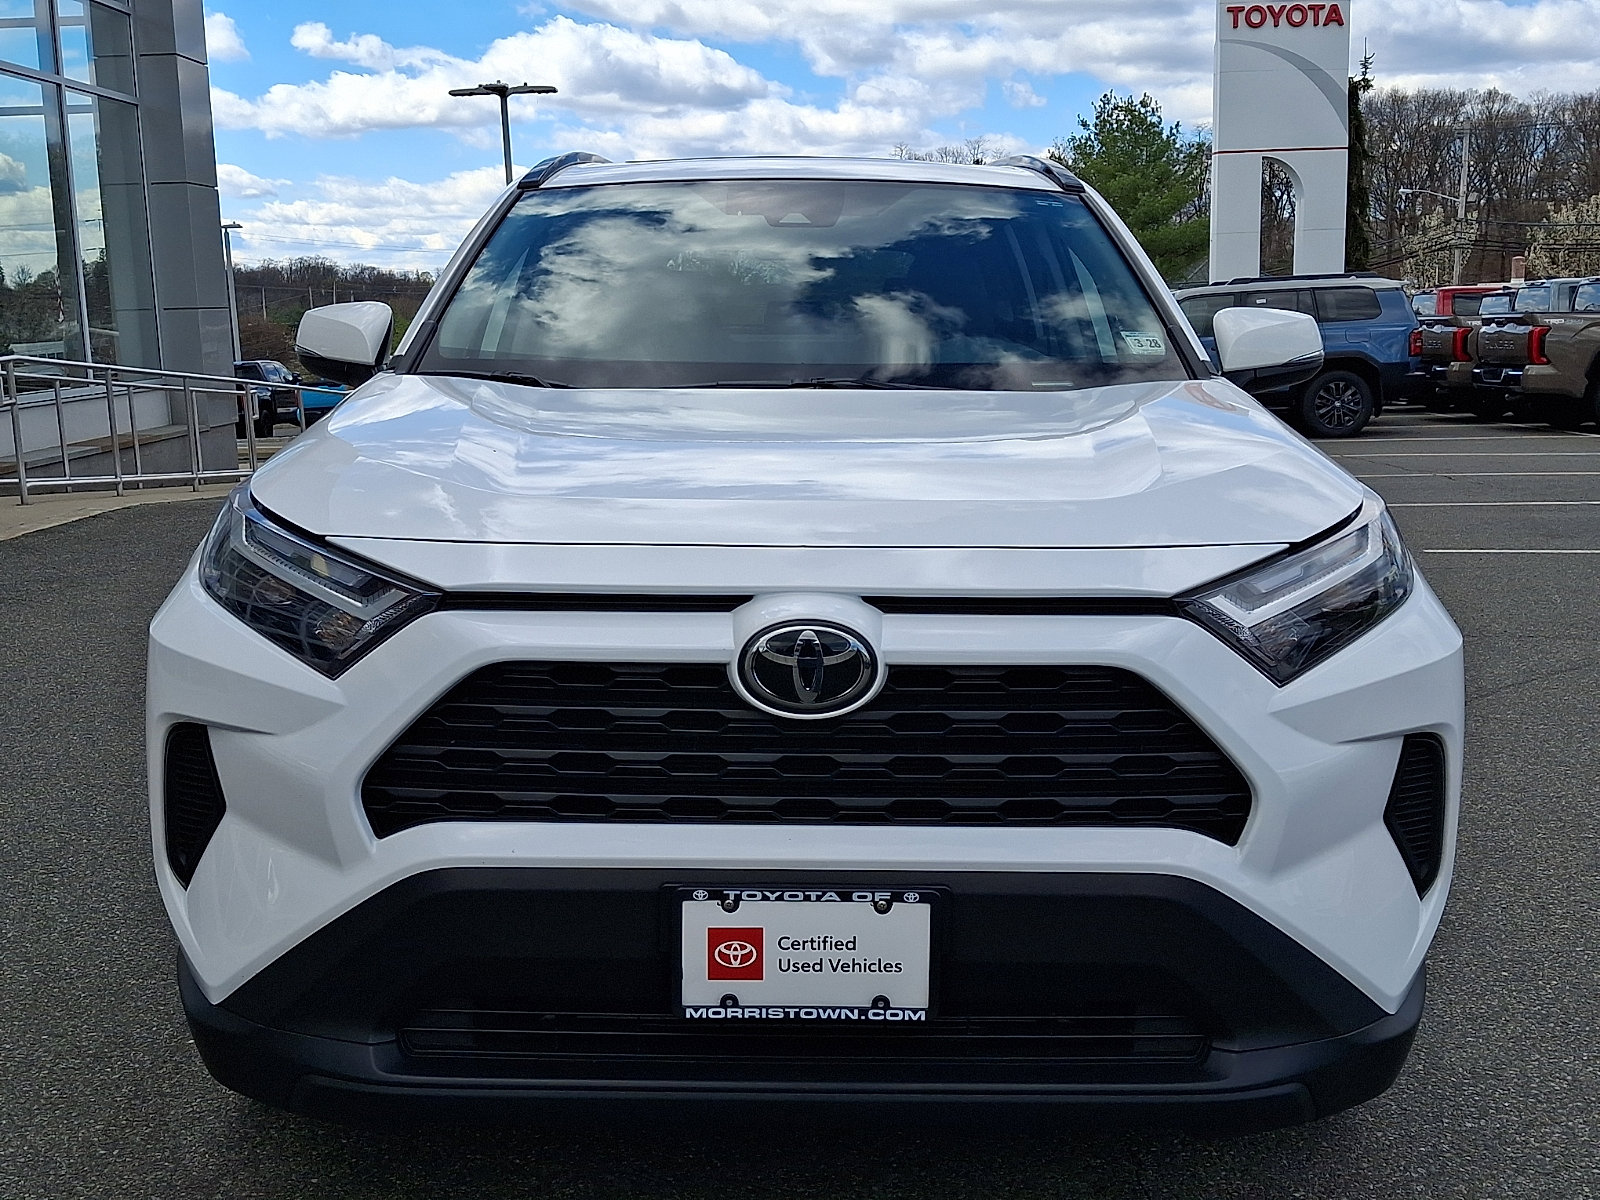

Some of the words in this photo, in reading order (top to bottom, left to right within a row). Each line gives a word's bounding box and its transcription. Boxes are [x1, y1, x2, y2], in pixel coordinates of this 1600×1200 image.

[1226, 3, 1345, 29] TOYOTA
[1134, 338, 1144, 348] 3
[1146, 338, 1162, 348] 28
[723, 890, 842, 902] TOYOTA
[852, 891, 892, 902] OF
[777, 936, 857, 952] Certified
[778, 957, 824, 974] Used
[828, 957, 903, 974] Vehicles
[685, 1007, 926, 1021] MORRISTOWN.COM
